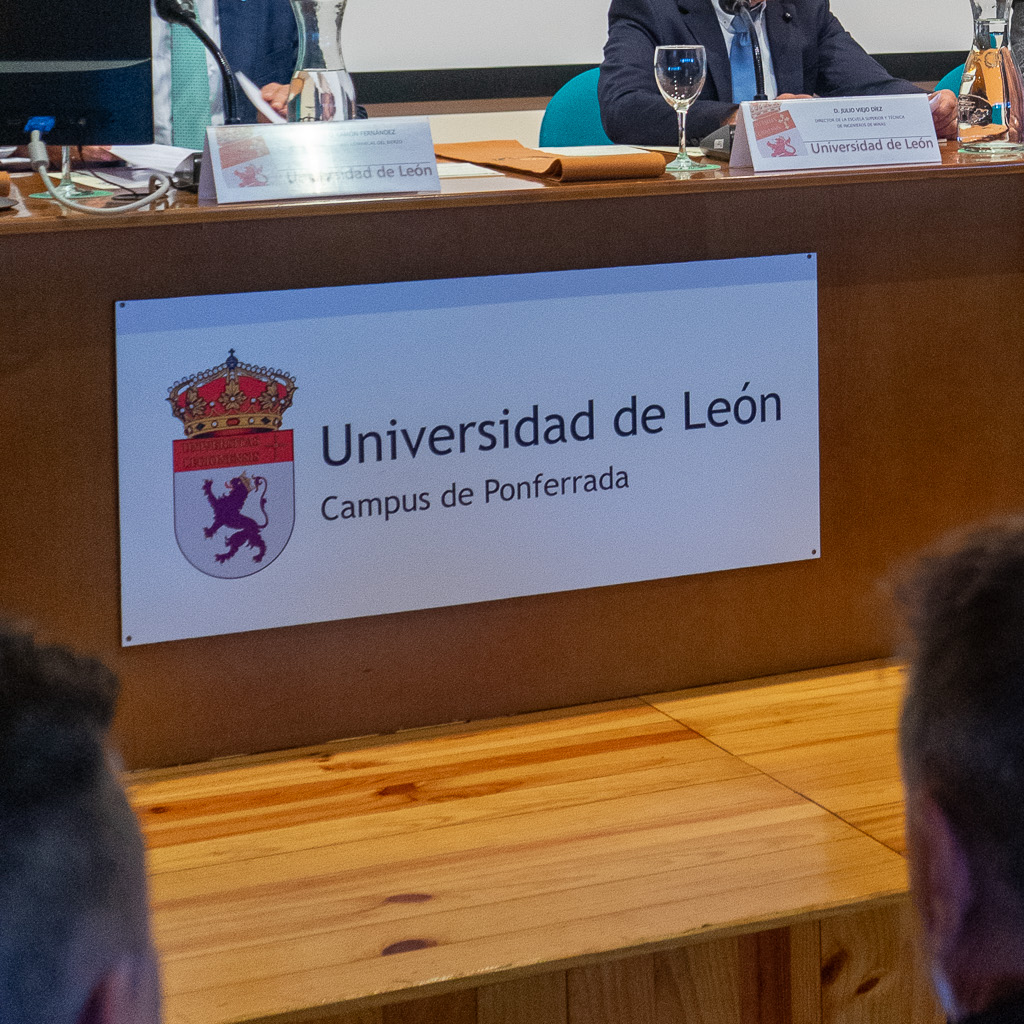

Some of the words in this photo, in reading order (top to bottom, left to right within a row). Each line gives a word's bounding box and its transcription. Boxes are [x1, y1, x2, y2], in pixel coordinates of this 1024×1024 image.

[810, 139, 883, 154] Universidad
[887, 139, 902, 150] de
[905, 137, 934, 149] León
[377, 166, 395, 178] de
[399, 164, 433, 177] León
[321, 399, 595, 466] Universidad
[613, 396, 665, 437] de
[683, 382, 783, 430] León
[321, 489, 431, 522] Campus
[441, 482, 474, 509] de
[484, 466, 630, 503] Ponferrada
